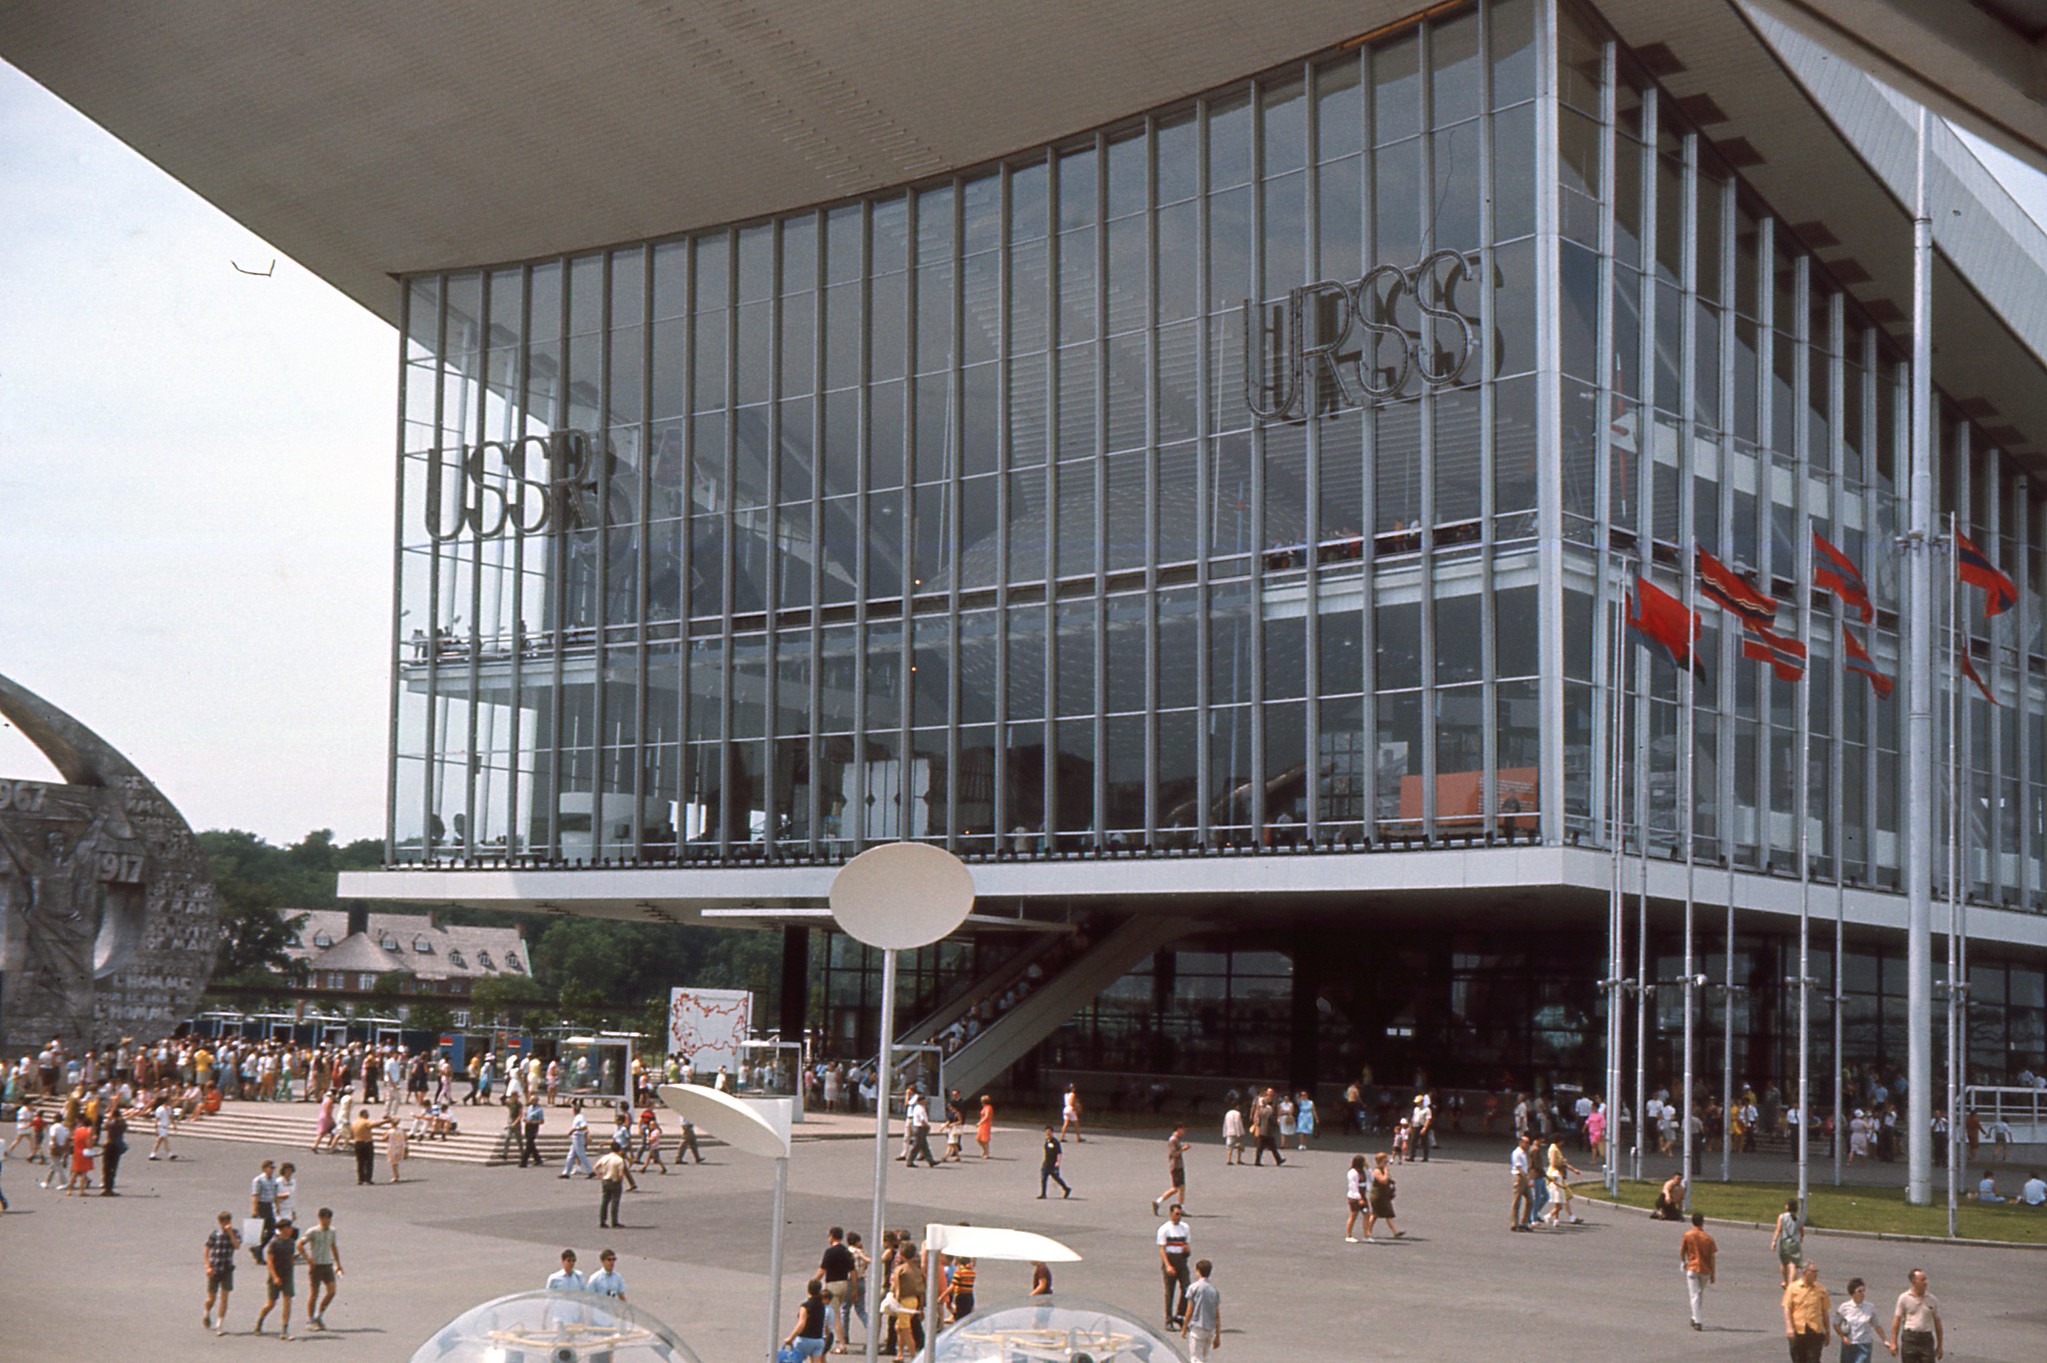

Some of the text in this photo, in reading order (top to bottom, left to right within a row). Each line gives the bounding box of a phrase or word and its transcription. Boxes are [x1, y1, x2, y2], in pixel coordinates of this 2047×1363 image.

[1243, 248, 1473, 421] URSS
[425, 427, 593, 541] USSR
[95, 852, 145, 883] 1917
[171, 938, 211, 951] MAN
